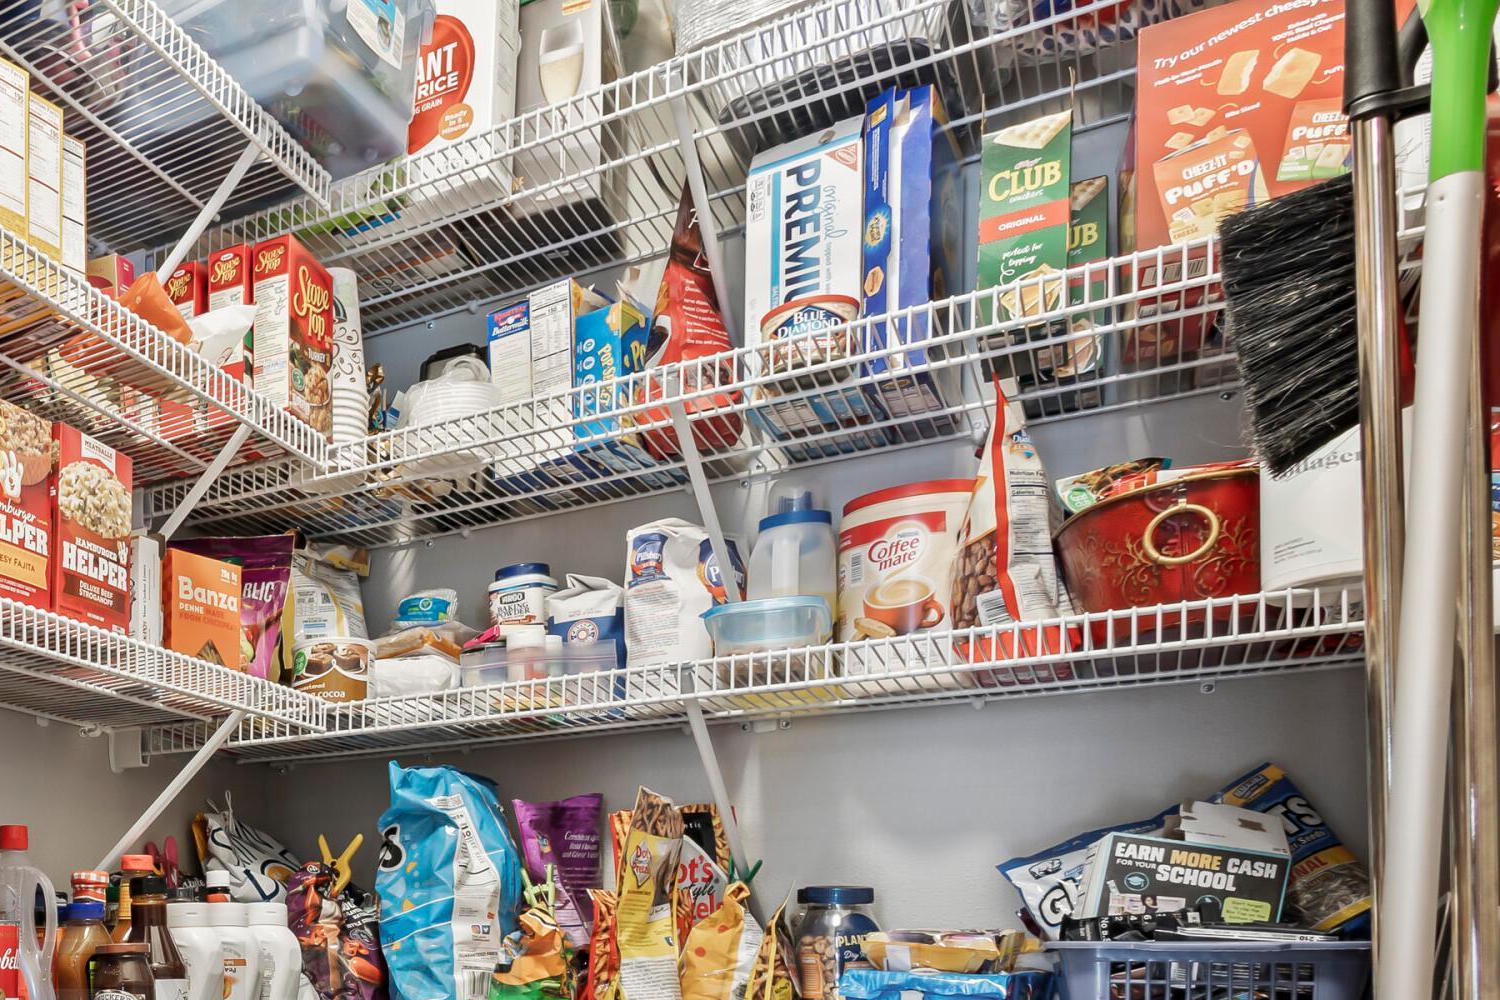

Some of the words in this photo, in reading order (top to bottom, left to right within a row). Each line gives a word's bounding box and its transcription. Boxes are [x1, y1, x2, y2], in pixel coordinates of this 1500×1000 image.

[1154, 57, 1177, 69] Try
[1179, 42, 1205, 60] our
[1207, 13, 1263, 46] newest
[418, 72, 459, 100] RICE
[988, 160, 1061, 202] CLUB
[1164, 159, 1256, 205] PUFF'D
[783, 158, 821, 304] PREMIU
[998, 212, 1046, 231] ORIGINAL
[257, 244, 285, 270] Stove
[268, 257, 282, 271] Top
[294, 266, 330, 317] Stove
[307, 311, 326, 337] Top
[794, 309, 827, 324] BLUE
[868, 536, 921, 564] Coffee
[878, 548, 917, 571] mate
[14, 555, 35, 574] FAJITA
[62, 542, 128, 590] HELPER
[178, 576, 238, 614] Banza
[498, 603, 528, 613] BAKING
[179, 603, 205, 614] PENNE
[496, 608, 530, 620] POWDER
[1115, 842, 1165, 863] EARN
[1170, 848, 1222, 871] MORE
[1226, 858, 1278, 879] CASH
[1116, 856, 1133, 865] FOR
[1135, 859, 1157, 870] YOUR
[1156, 864, 1237, 891] SCHOOL
